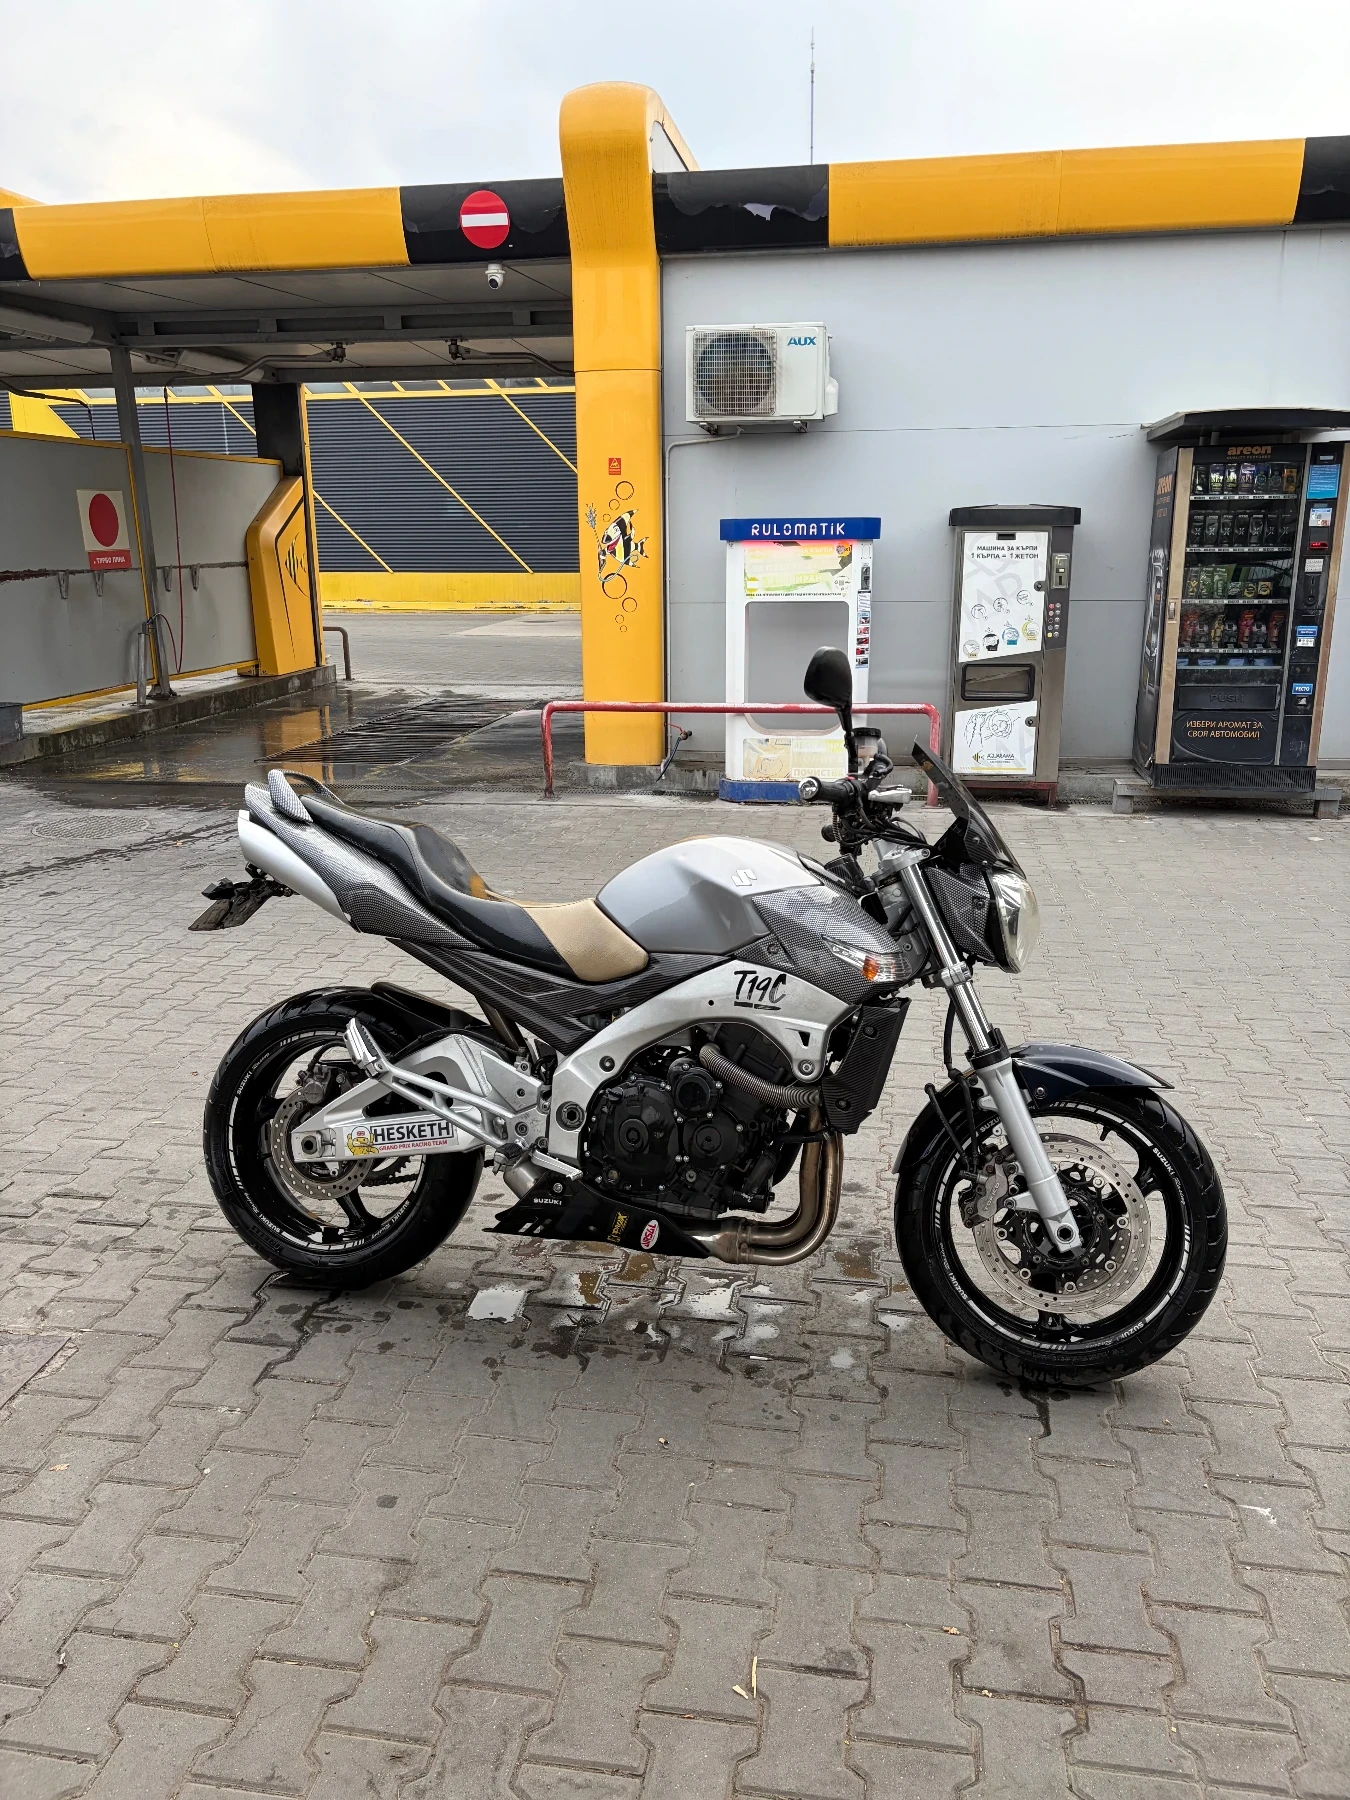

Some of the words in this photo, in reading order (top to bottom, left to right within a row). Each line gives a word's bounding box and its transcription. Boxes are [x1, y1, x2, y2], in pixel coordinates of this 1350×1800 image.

[787, 336, 817, 346] AUX
[1227, 446, 1272, 456] areon
[1209, 694, 1245, 703] PUSH
[1186, 720, 1216, 728] ИЗБЕРИ
[1217, 721, 1252, 729] АРОМАТ
[1252, 721, 1263, 729] ЗА
[1187, 730, 1209, 738] СВОЯ
[1209, 730, 1260, 739] АВТОМОБИЛ
[236, 1070, 253, 1095] SUZUKI
[373, 1121, 451, 1143] HESKETH
[979, 1116, 1001, 1133] SUZU
[1152, 1147, 1176, 1176] SUZUKI
[533, 1198, 562, 1206] SUZUKI
[259, 1213, 281, 1233] SUZUKI
[948, 1272, 969, 1300] SUZUKI
[1116, 1321, 1145, 1341] SUZUKI
